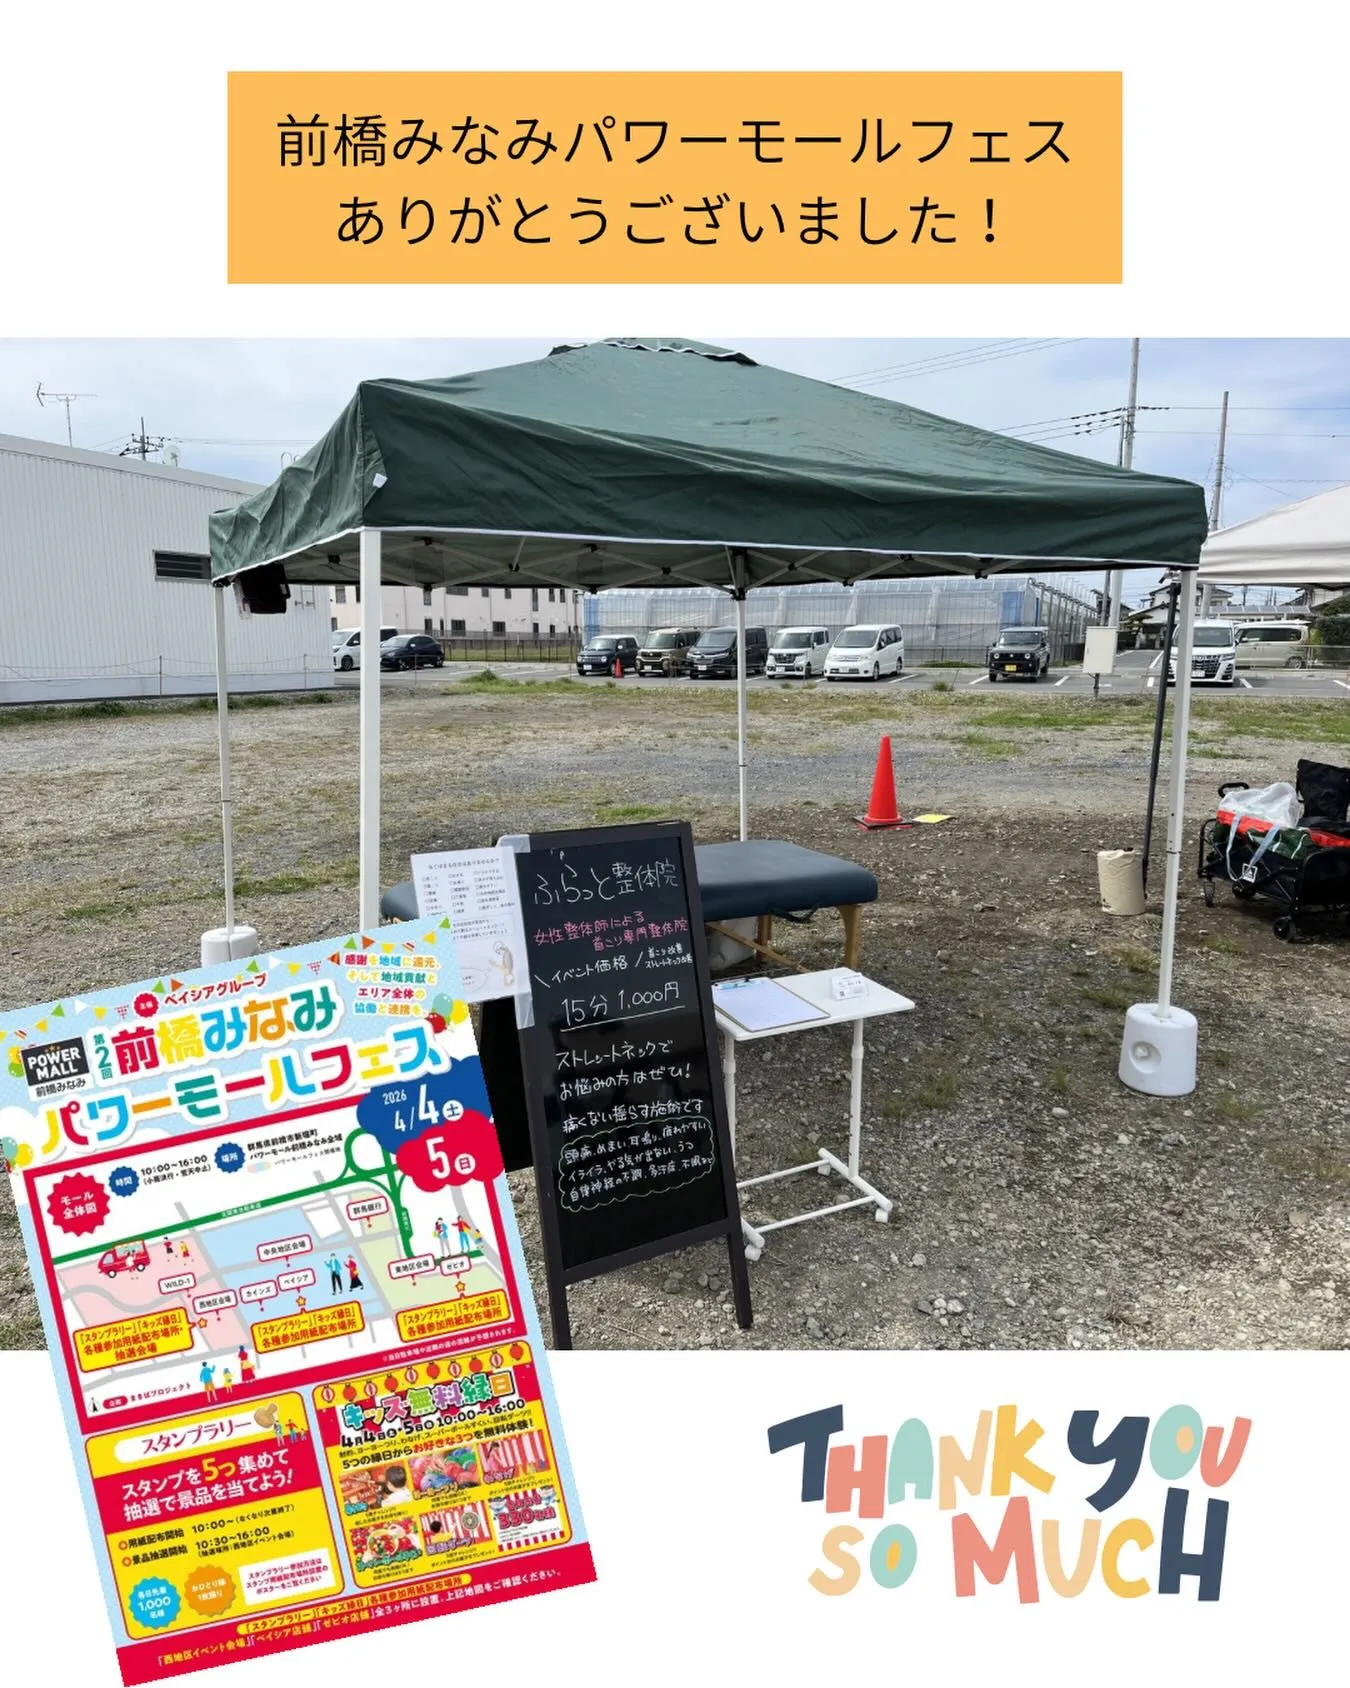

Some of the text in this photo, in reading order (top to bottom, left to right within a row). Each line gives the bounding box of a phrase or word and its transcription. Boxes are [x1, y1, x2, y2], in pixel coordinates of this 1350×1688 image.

[534, 857, 678, 905] ふらっと整体院
[534, 911, 644, 946] 女性整体師による
[551, 955, 629, 983] イベント価格
[560, 995, 609, 1027] 15分
